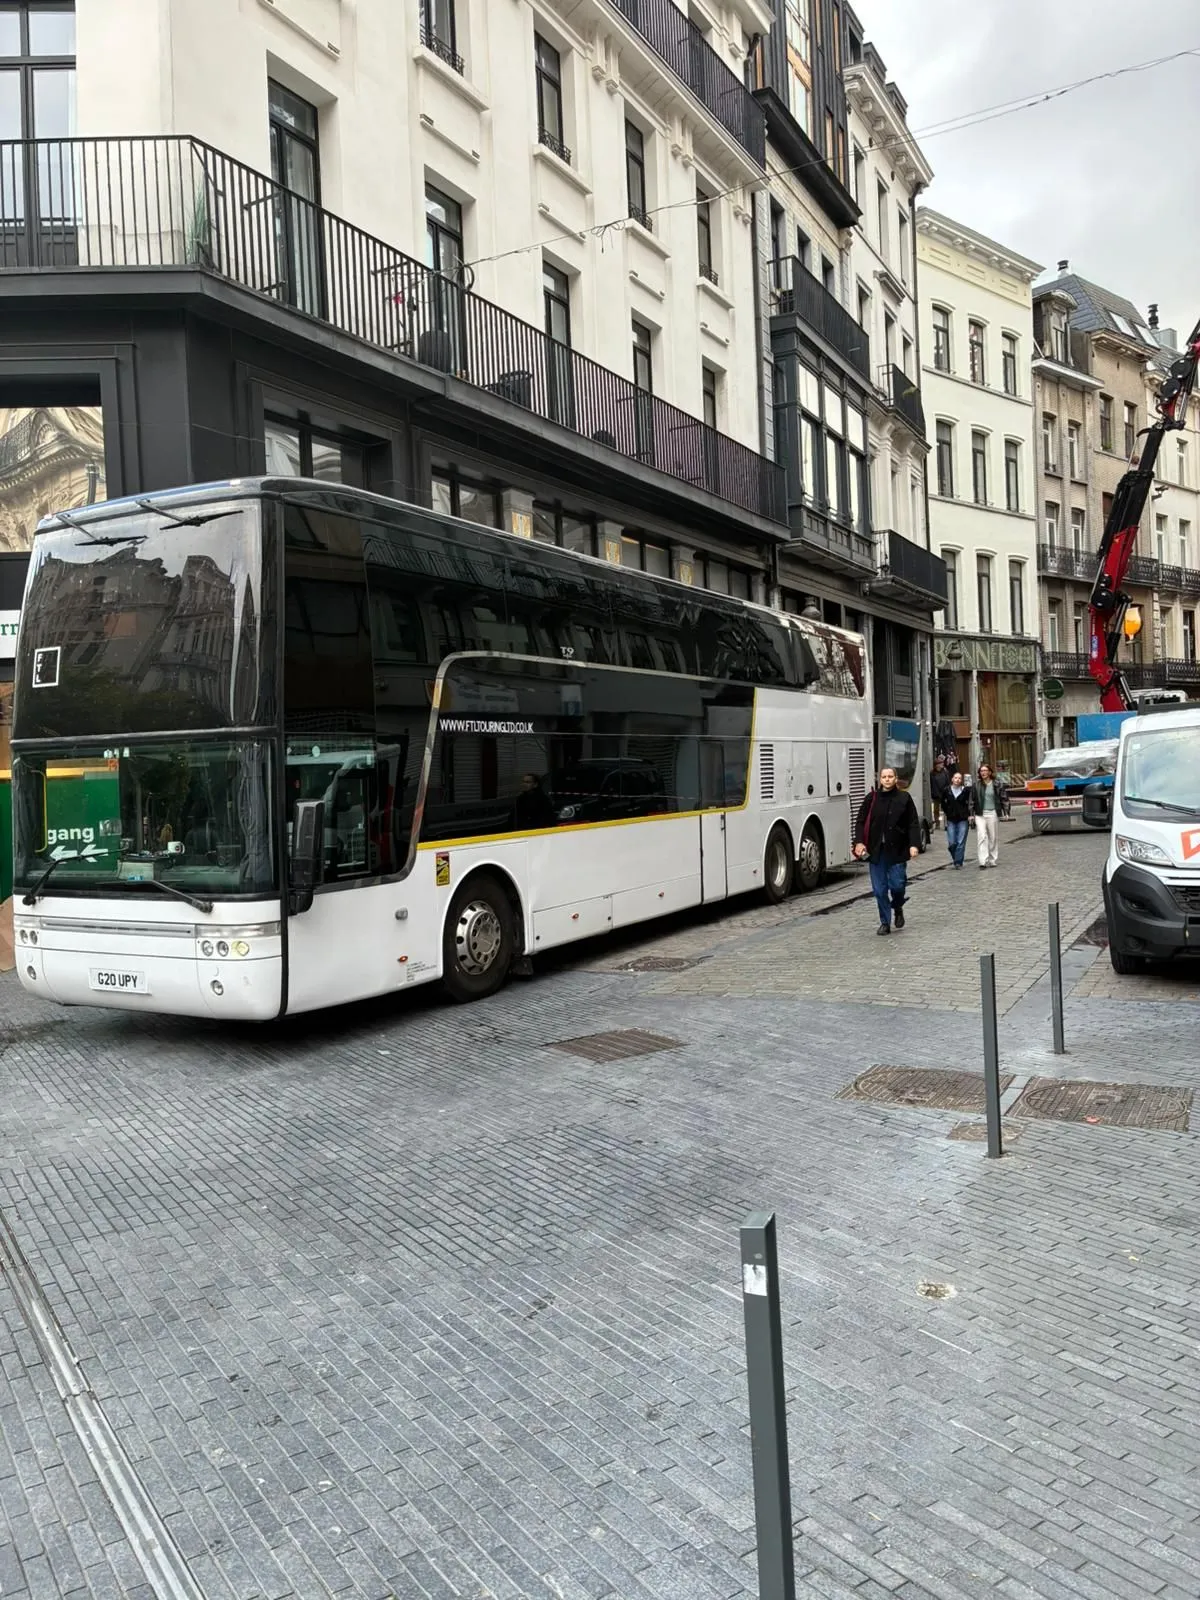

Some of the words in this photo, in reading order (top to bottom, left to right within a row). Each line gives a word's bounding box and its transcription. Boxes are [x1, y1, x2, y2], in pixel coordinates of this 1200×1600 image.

[560, 646, 575, 656] T9
[97, 972, 116, 986] G20
[118, 974, 138, 988] UPY
